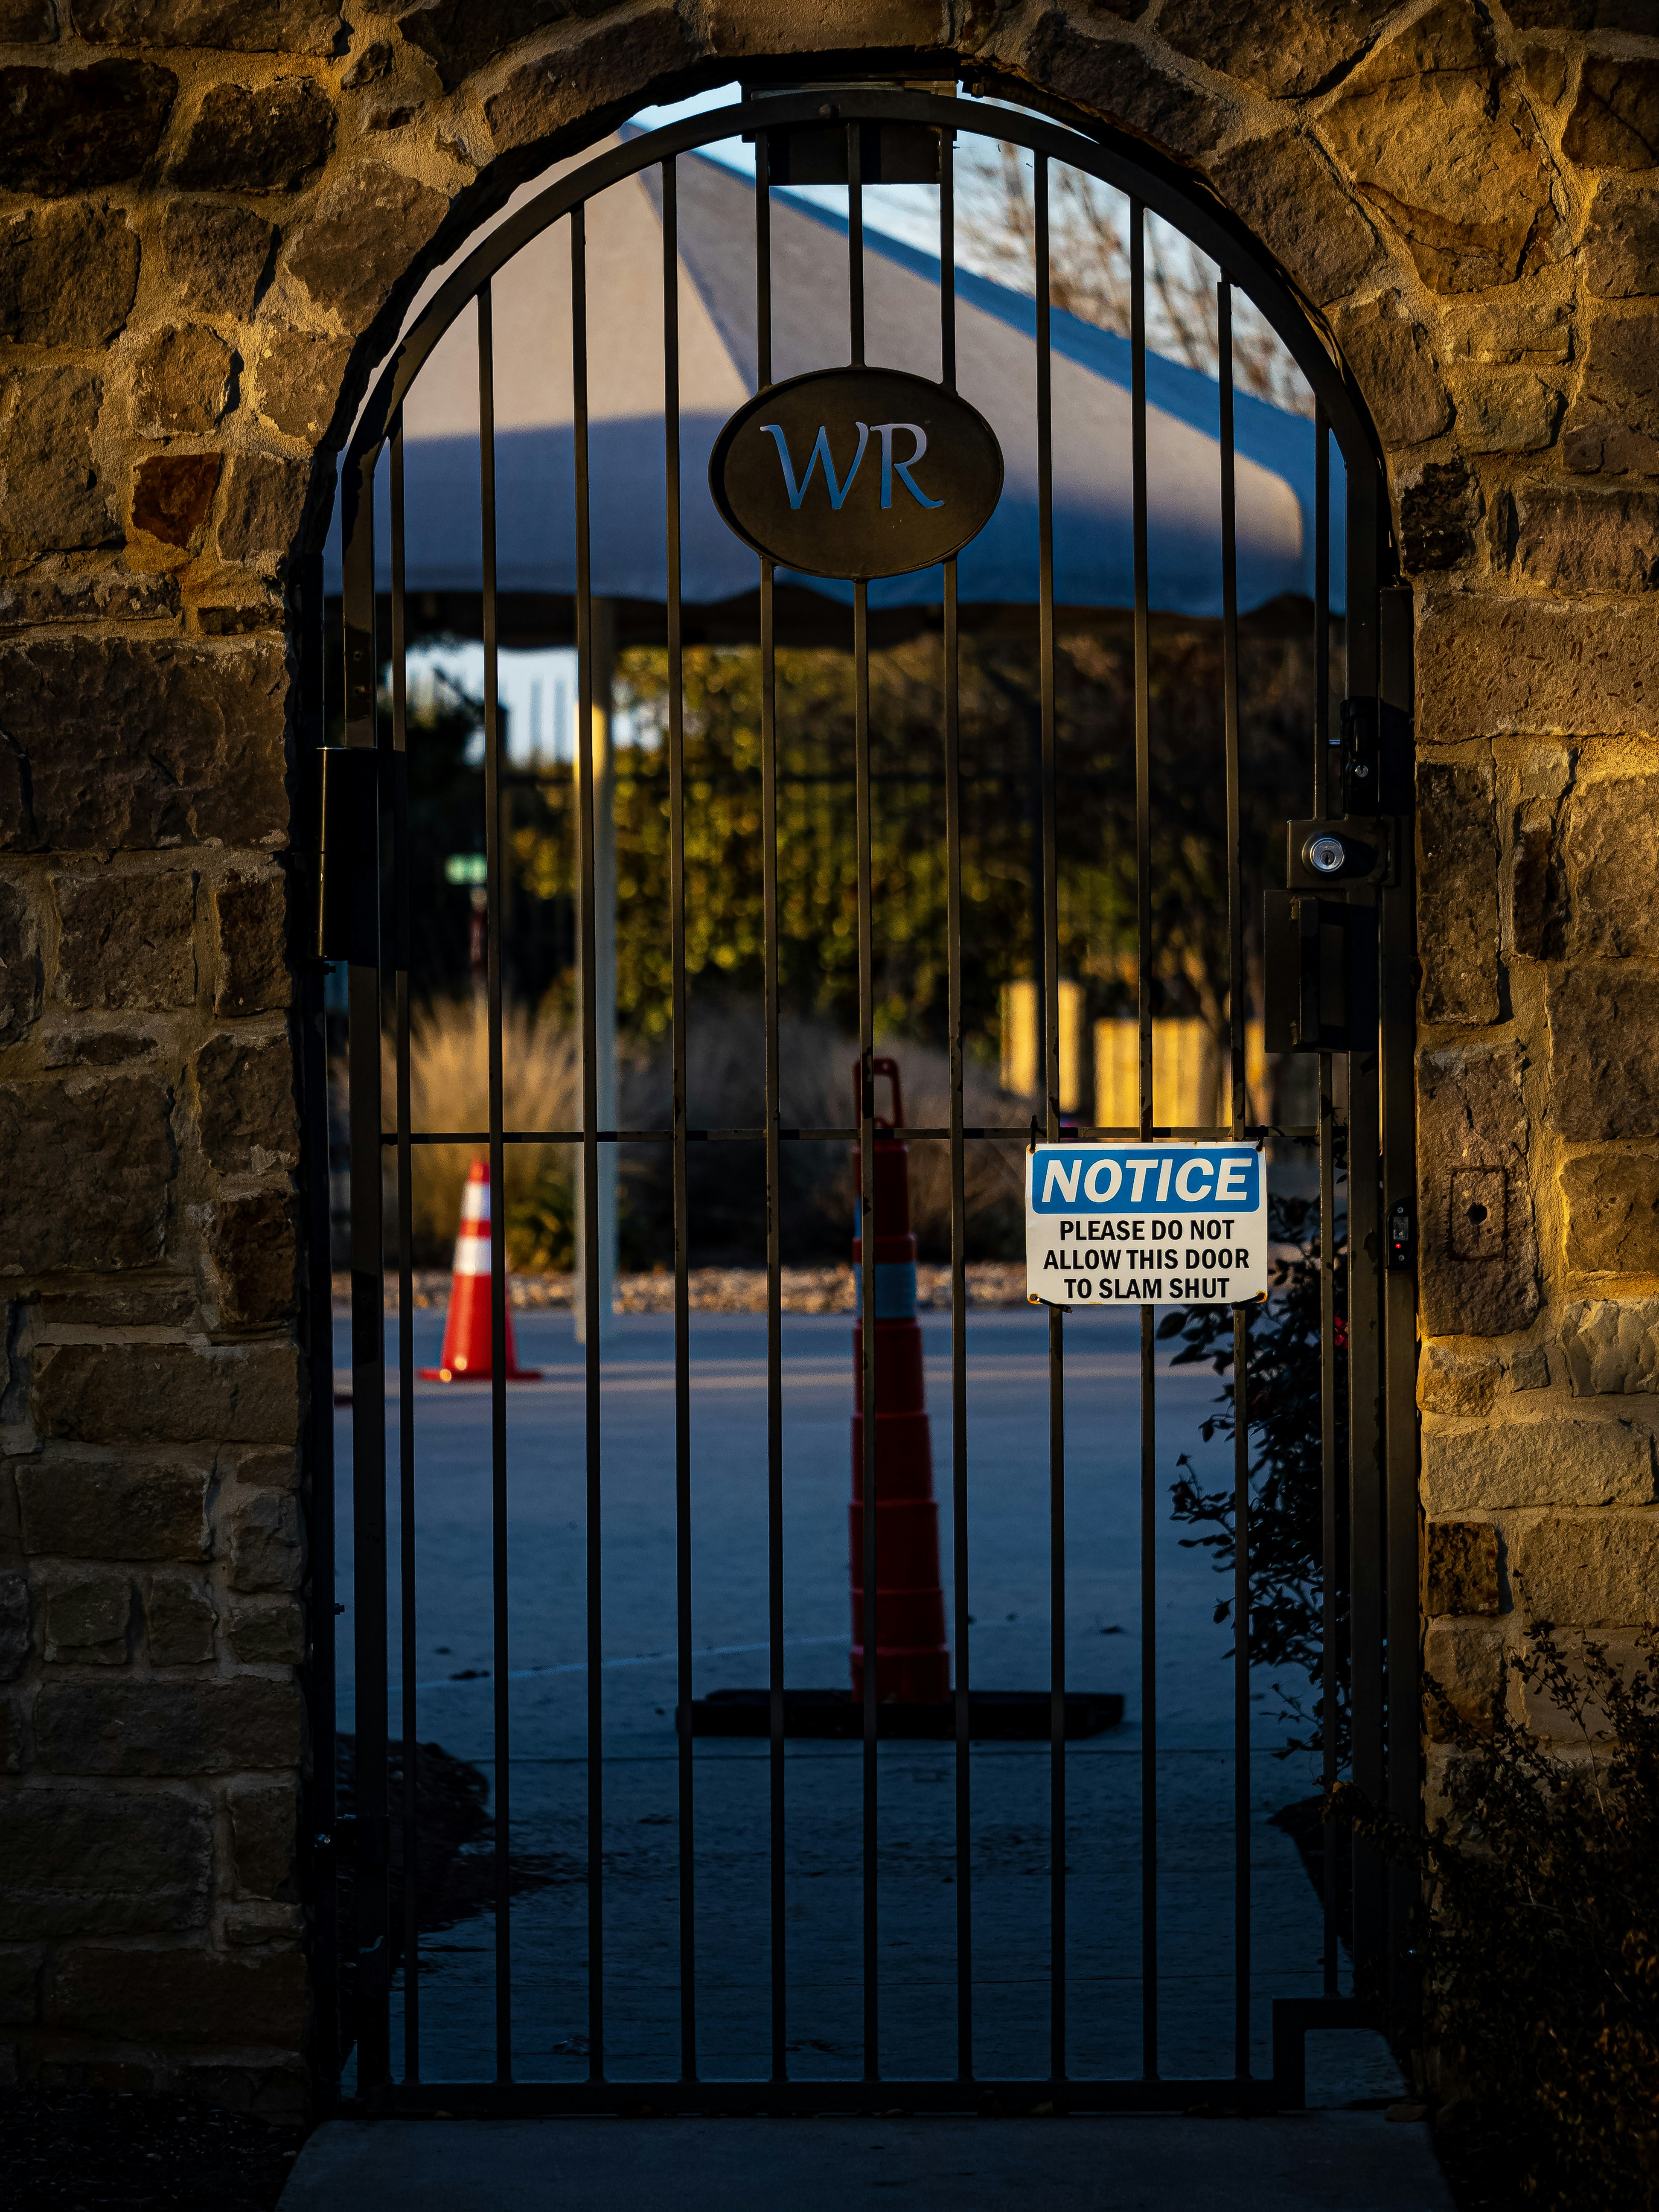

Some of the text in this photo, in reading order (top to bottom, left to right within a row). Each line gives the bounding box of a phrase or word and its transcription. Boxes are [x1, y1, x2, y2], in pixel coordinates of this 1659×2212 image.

[760, 421, 944, 509] WR
[1042, 1158, 1252, 1203] NOTICE
[1060, 1220, 1234, 1240] PLEASE DO NOT
[1043, 1249, 1249, 1270] ALLOW THIS DOOR
[1064, 1278, 1230, 1298] TO SLAM SHUT
